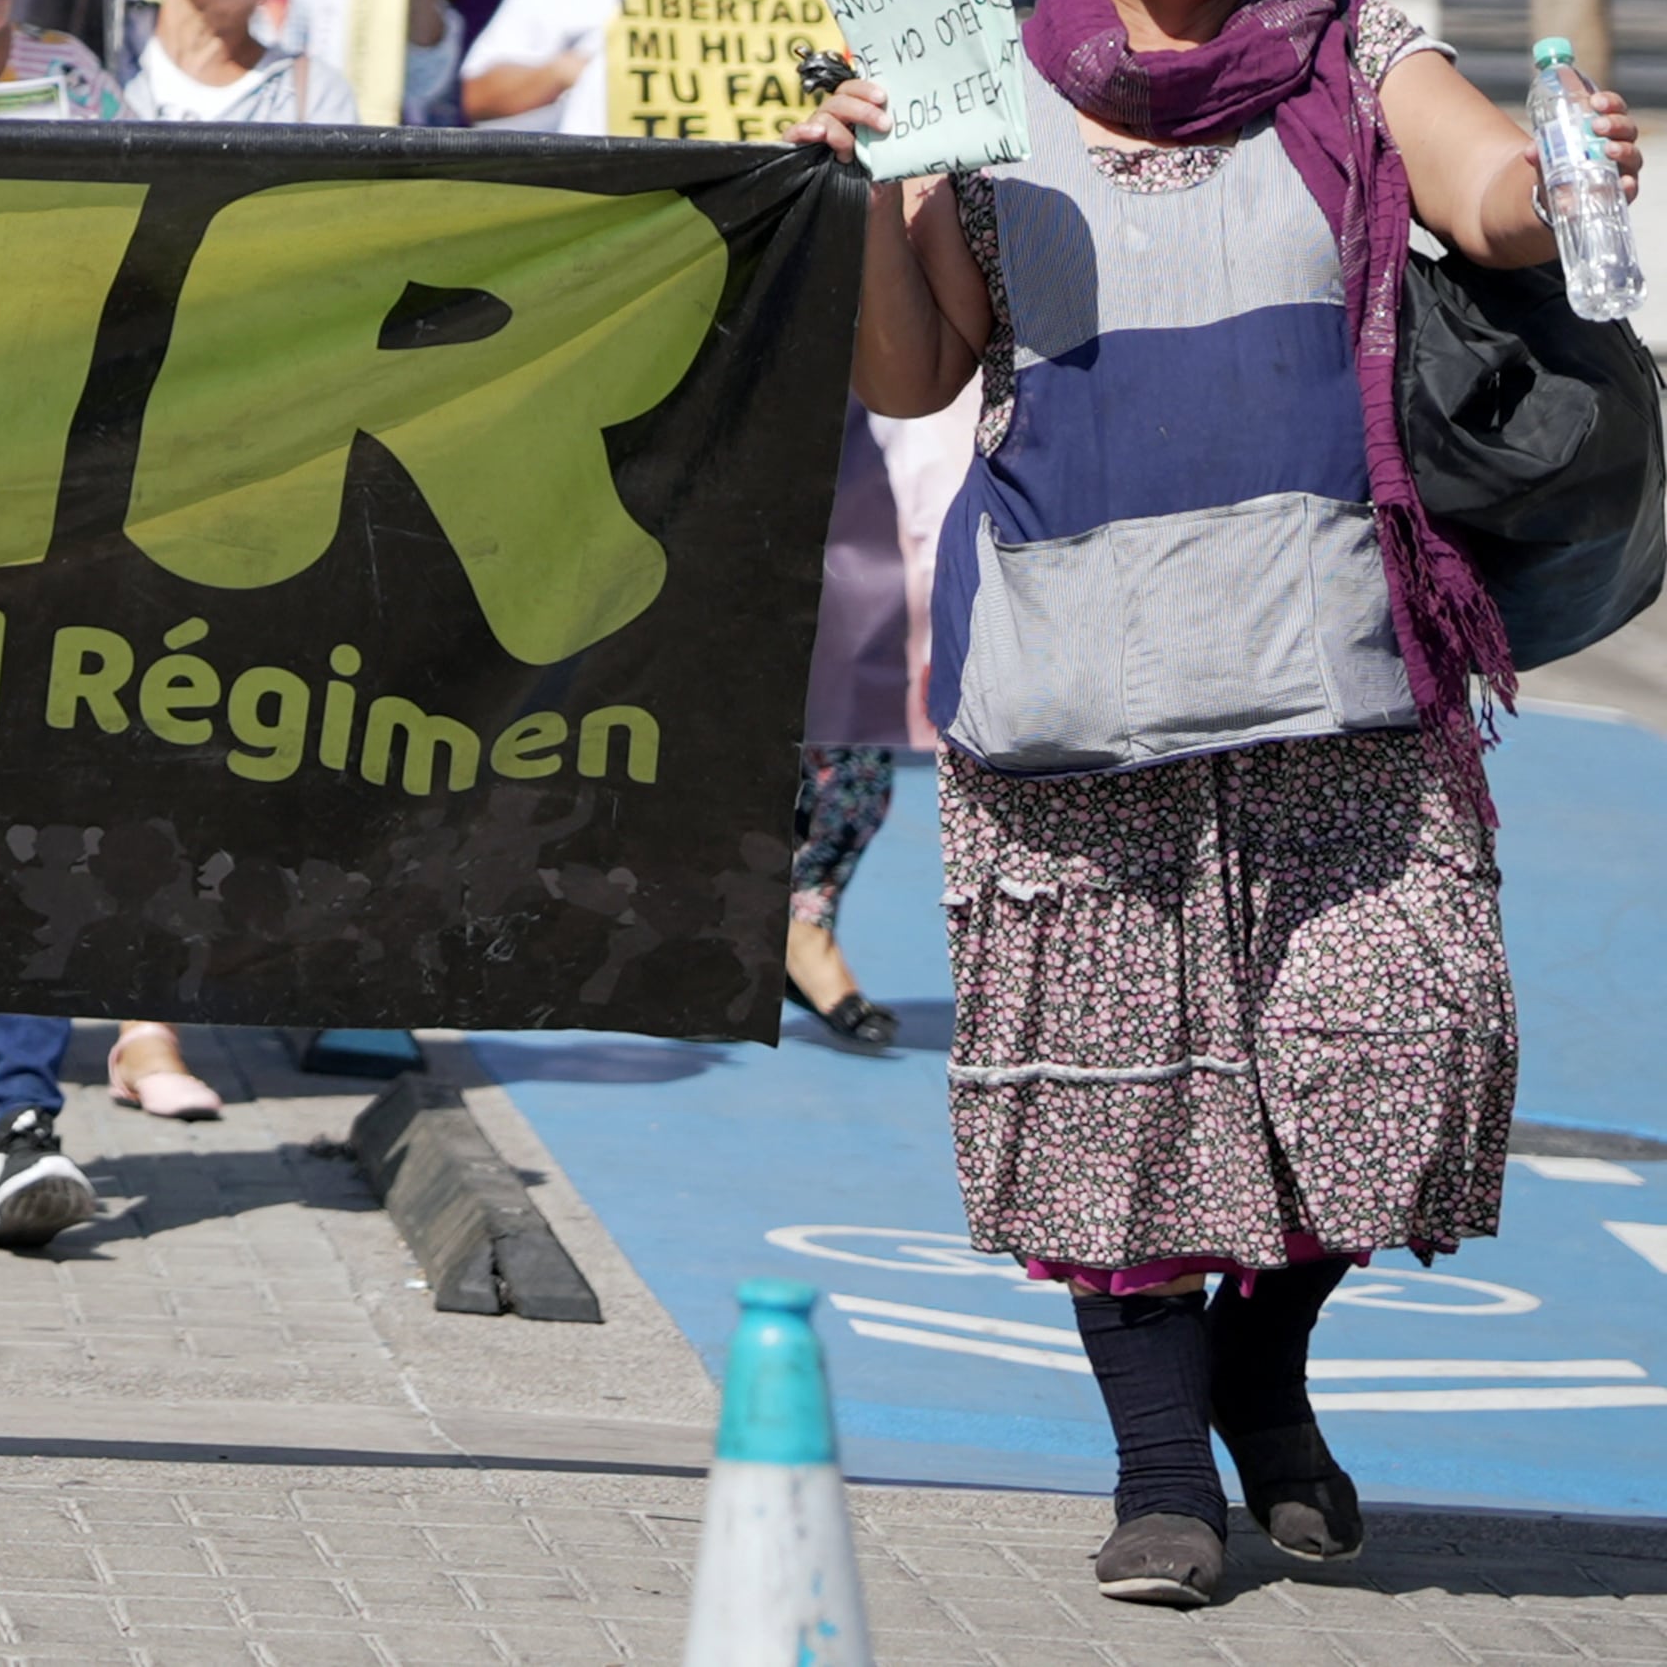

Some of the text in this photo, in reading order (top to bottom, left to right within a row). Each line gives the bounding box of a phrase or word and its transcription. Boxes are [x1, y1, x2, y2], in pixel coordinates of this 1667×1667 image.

[628, 27, 815, 65] MI HIJO
[629, 69, 700, 104] TU
[46, 617, 660, 796] Régimen
